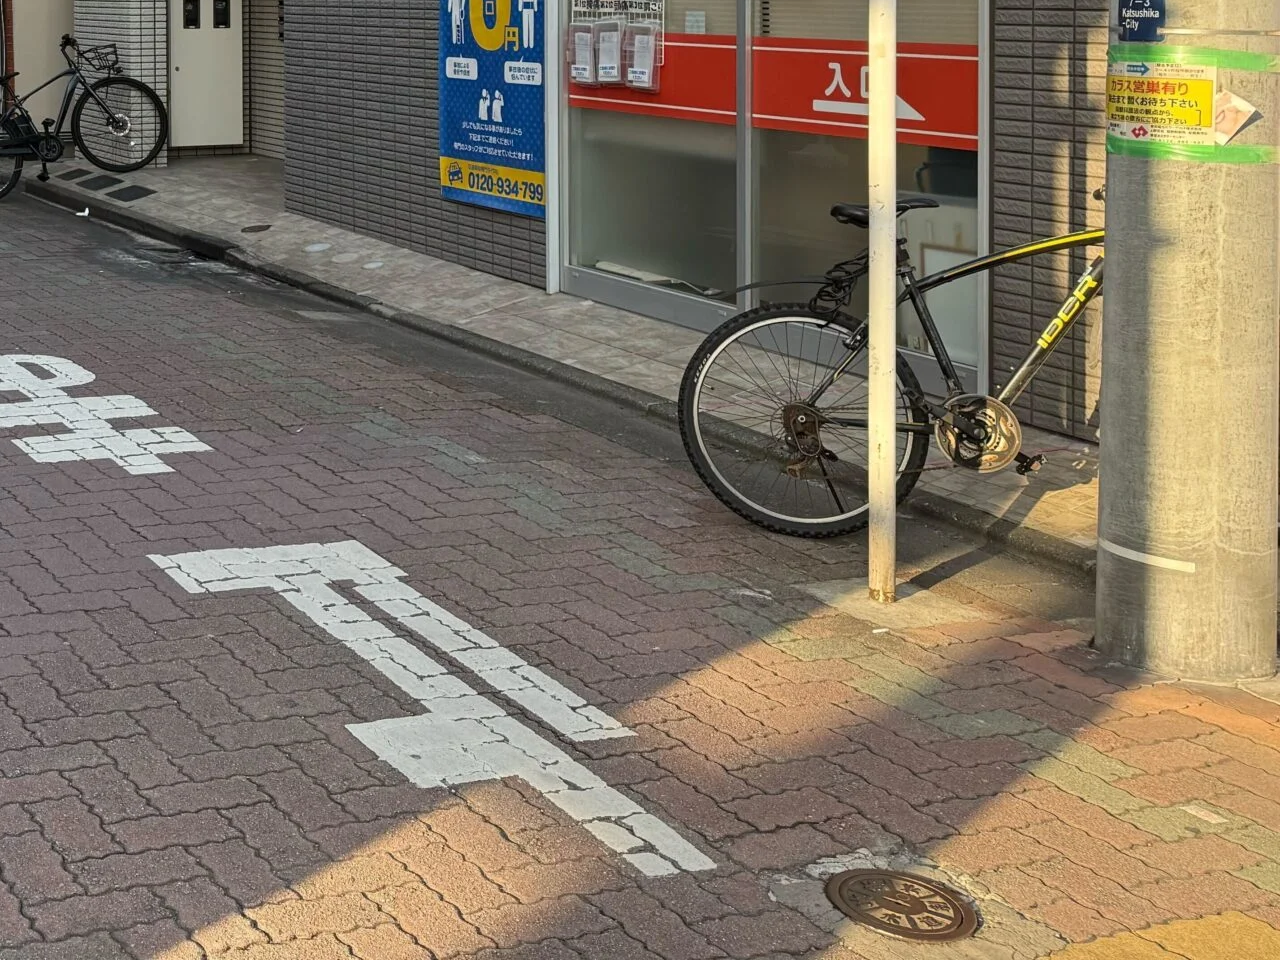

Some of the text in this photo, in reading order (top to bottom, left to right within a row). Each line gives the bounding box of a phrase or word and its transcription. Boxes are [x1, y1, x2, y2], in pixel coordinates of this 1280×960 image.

[1122, 8, 1159, 18] Katsushika
[1122, 19, 1139, 31] -City
[468, 171, 544, 202] 0120-934-799
